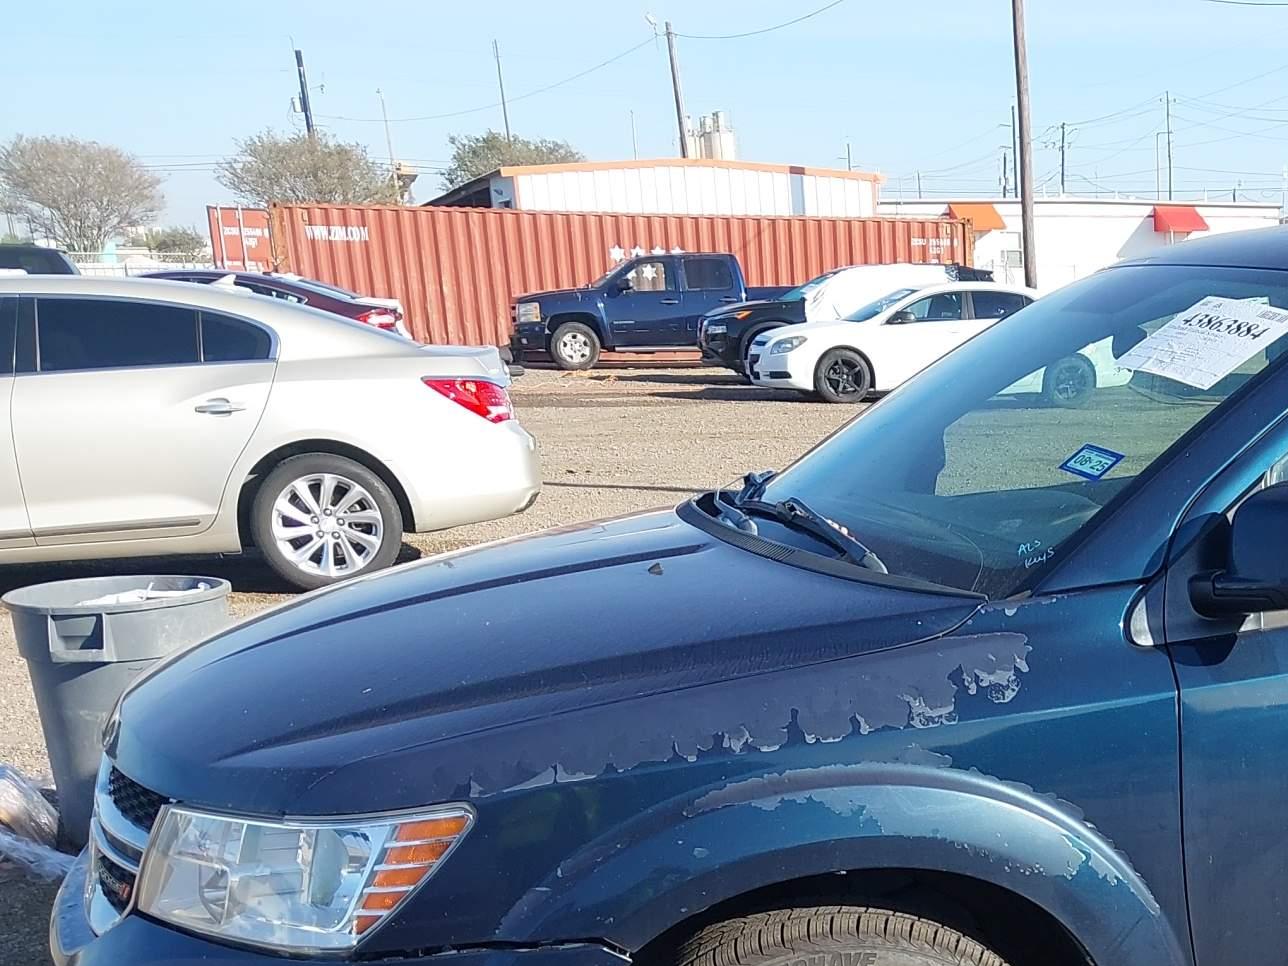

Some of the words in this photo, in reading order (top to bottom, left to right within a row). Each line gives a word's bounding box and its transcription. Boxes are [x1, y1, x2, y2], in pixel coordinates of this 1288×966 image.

[304, 225, 369, 241] WWW.ZIM.COM
[1182, 312, 1271, 341] 43863884
[1073, 454, 1091, 467] 08
[1089, 460, 1110, 472] 25
